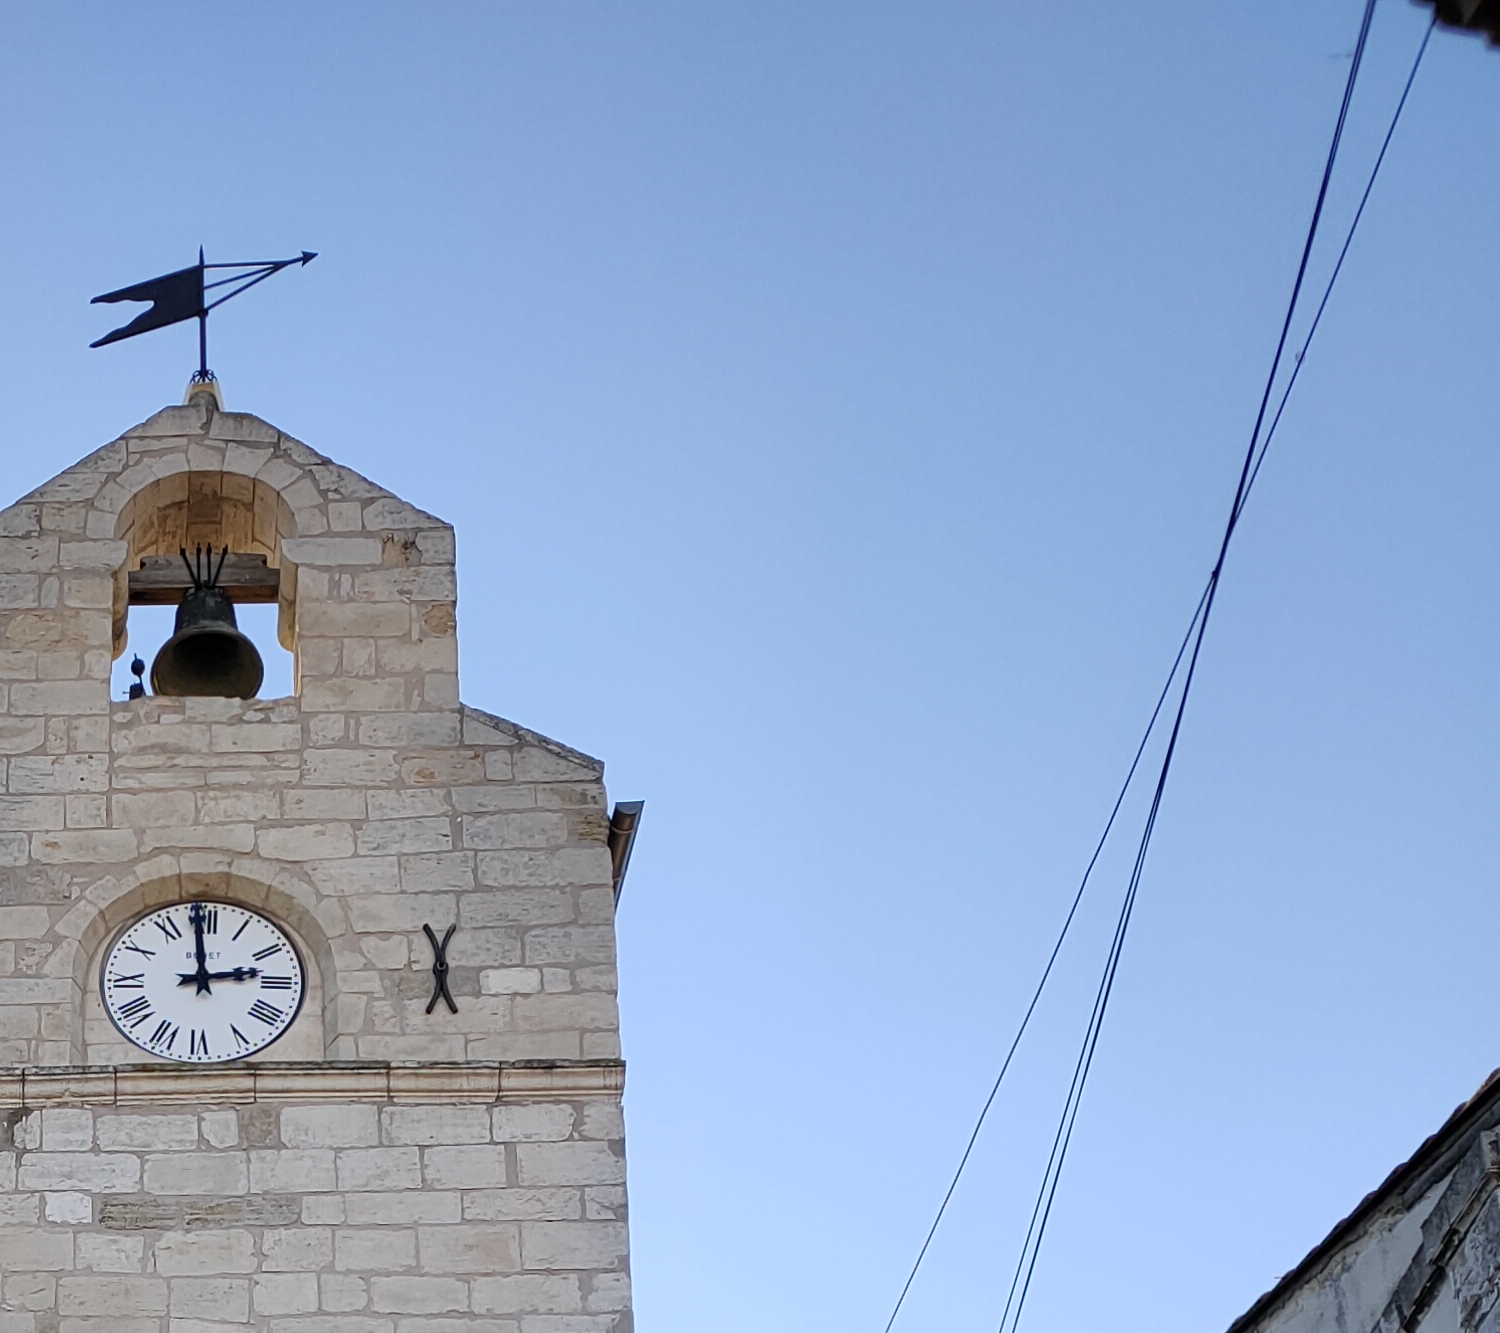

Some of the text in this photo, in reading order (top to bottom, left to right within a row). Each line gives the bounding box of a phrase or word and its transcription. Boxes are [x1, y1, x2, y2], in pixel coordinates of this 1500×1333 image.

[154, 914, 182, 945] XI
[194, 910, 218, 935] II
[125, 940, 156, 961] X
[252, 943, 283, 961] II
[113, 973, 144, 988] IX
[260, 976, 292, 989] III
[118, 995, 155, 1029] VIII
[248, 999, 284, 1026] IIII
[150, 1020, 179, 1051] VII
[190, 1029, 209, 1055] VI
[230, 1023, 250, 1048] V
